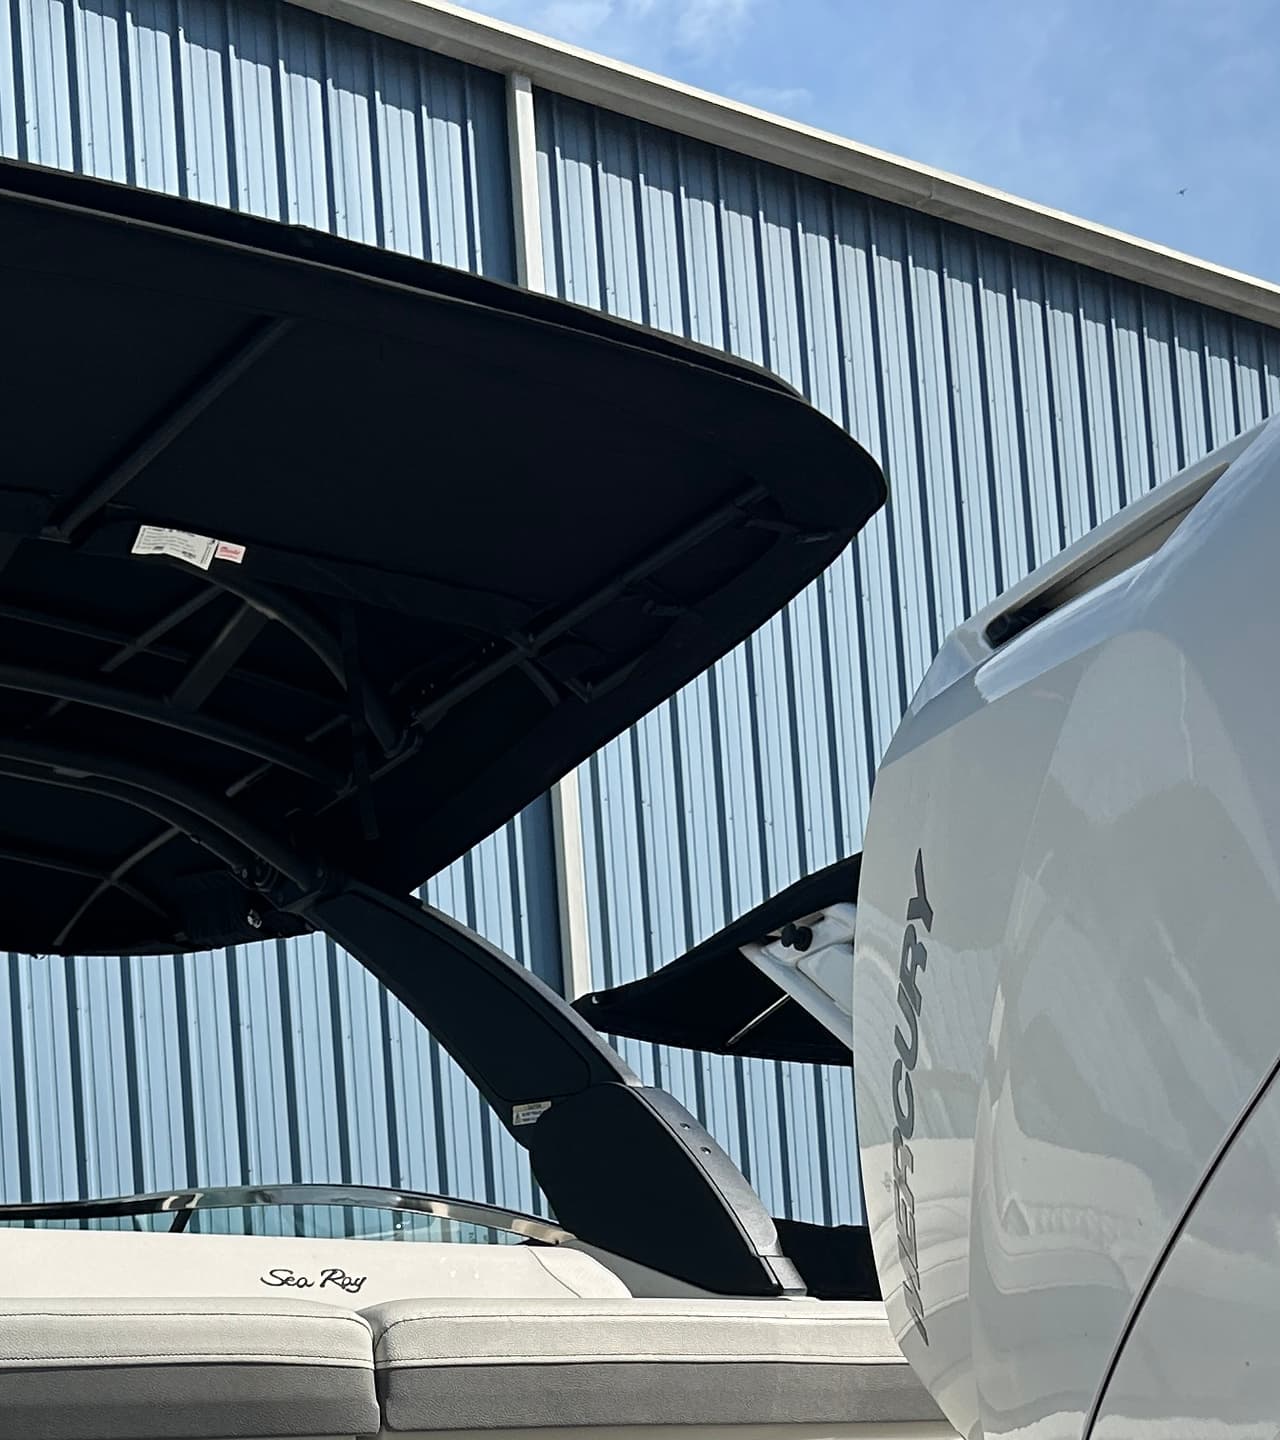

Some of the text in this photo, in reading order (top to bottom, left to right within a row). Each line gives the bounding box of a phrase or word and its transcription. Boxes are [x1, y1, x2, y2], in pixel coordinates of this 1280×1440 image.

[892, 848, 933, 1346] MERCURY
[260, 1268, 367, 1293] Sea Ray
